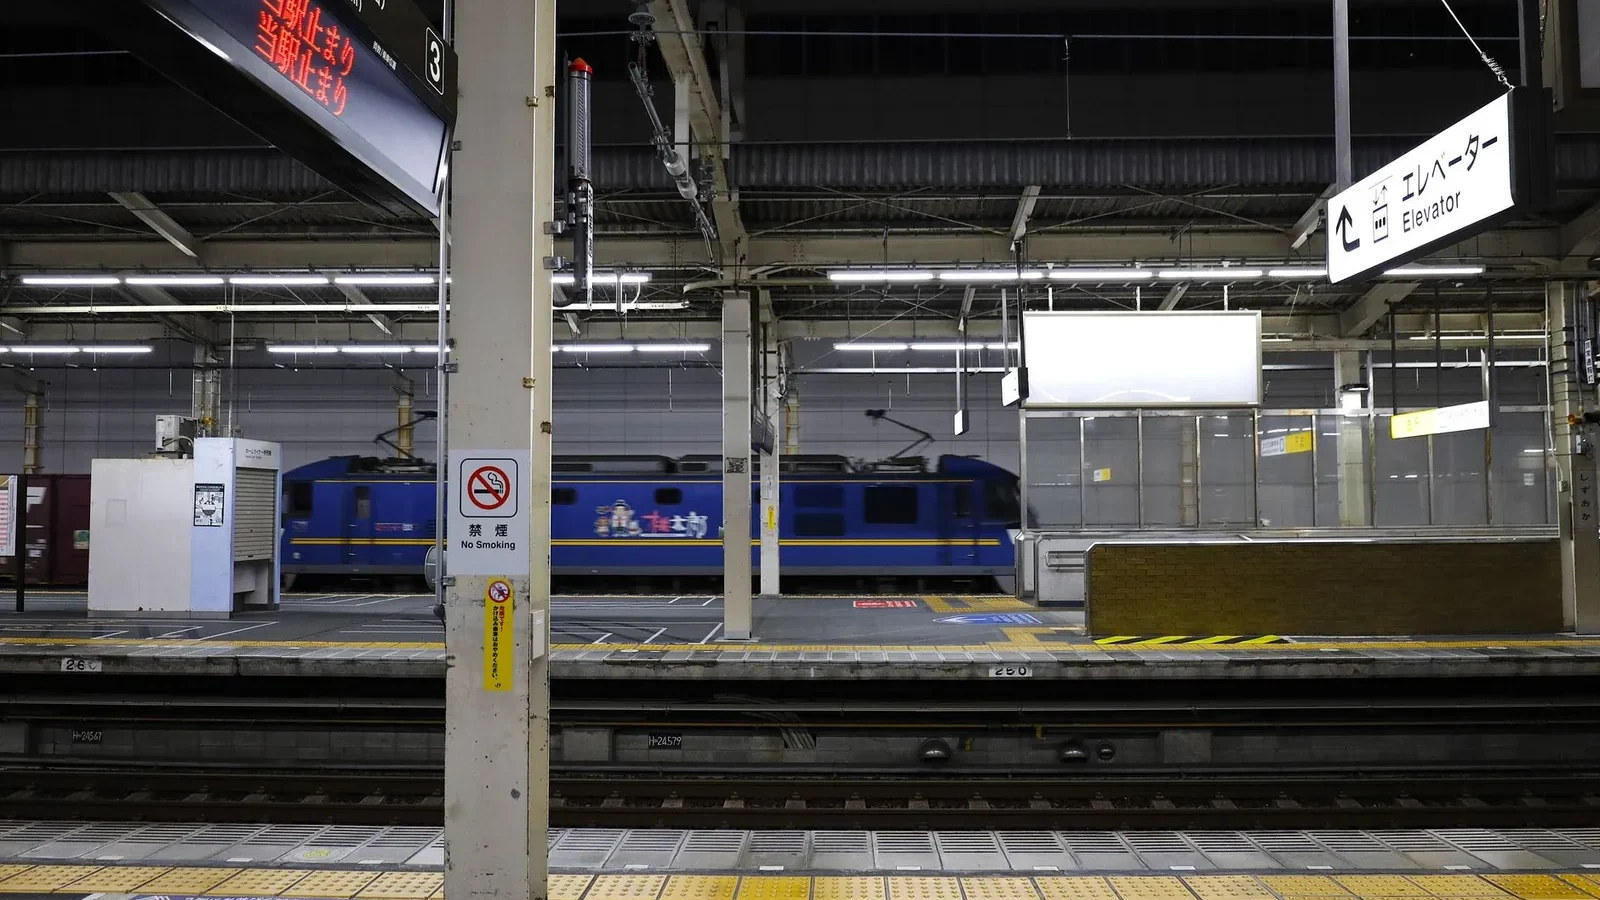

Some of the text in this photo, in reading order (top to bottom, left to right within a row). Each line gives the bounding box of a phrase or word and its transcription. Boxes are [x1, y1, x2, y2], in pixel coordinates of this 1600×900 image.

[255, 11, 347, 116] 当駅止まり
[429, 41, 441, 82] 3
[1402, 134, 1498, 202] エレベーター
[1403, 191, 1461, 233] Elevator
[1580, 473, 1591, 521] しずおか
[461, 541, 516, 551] No Smoking
